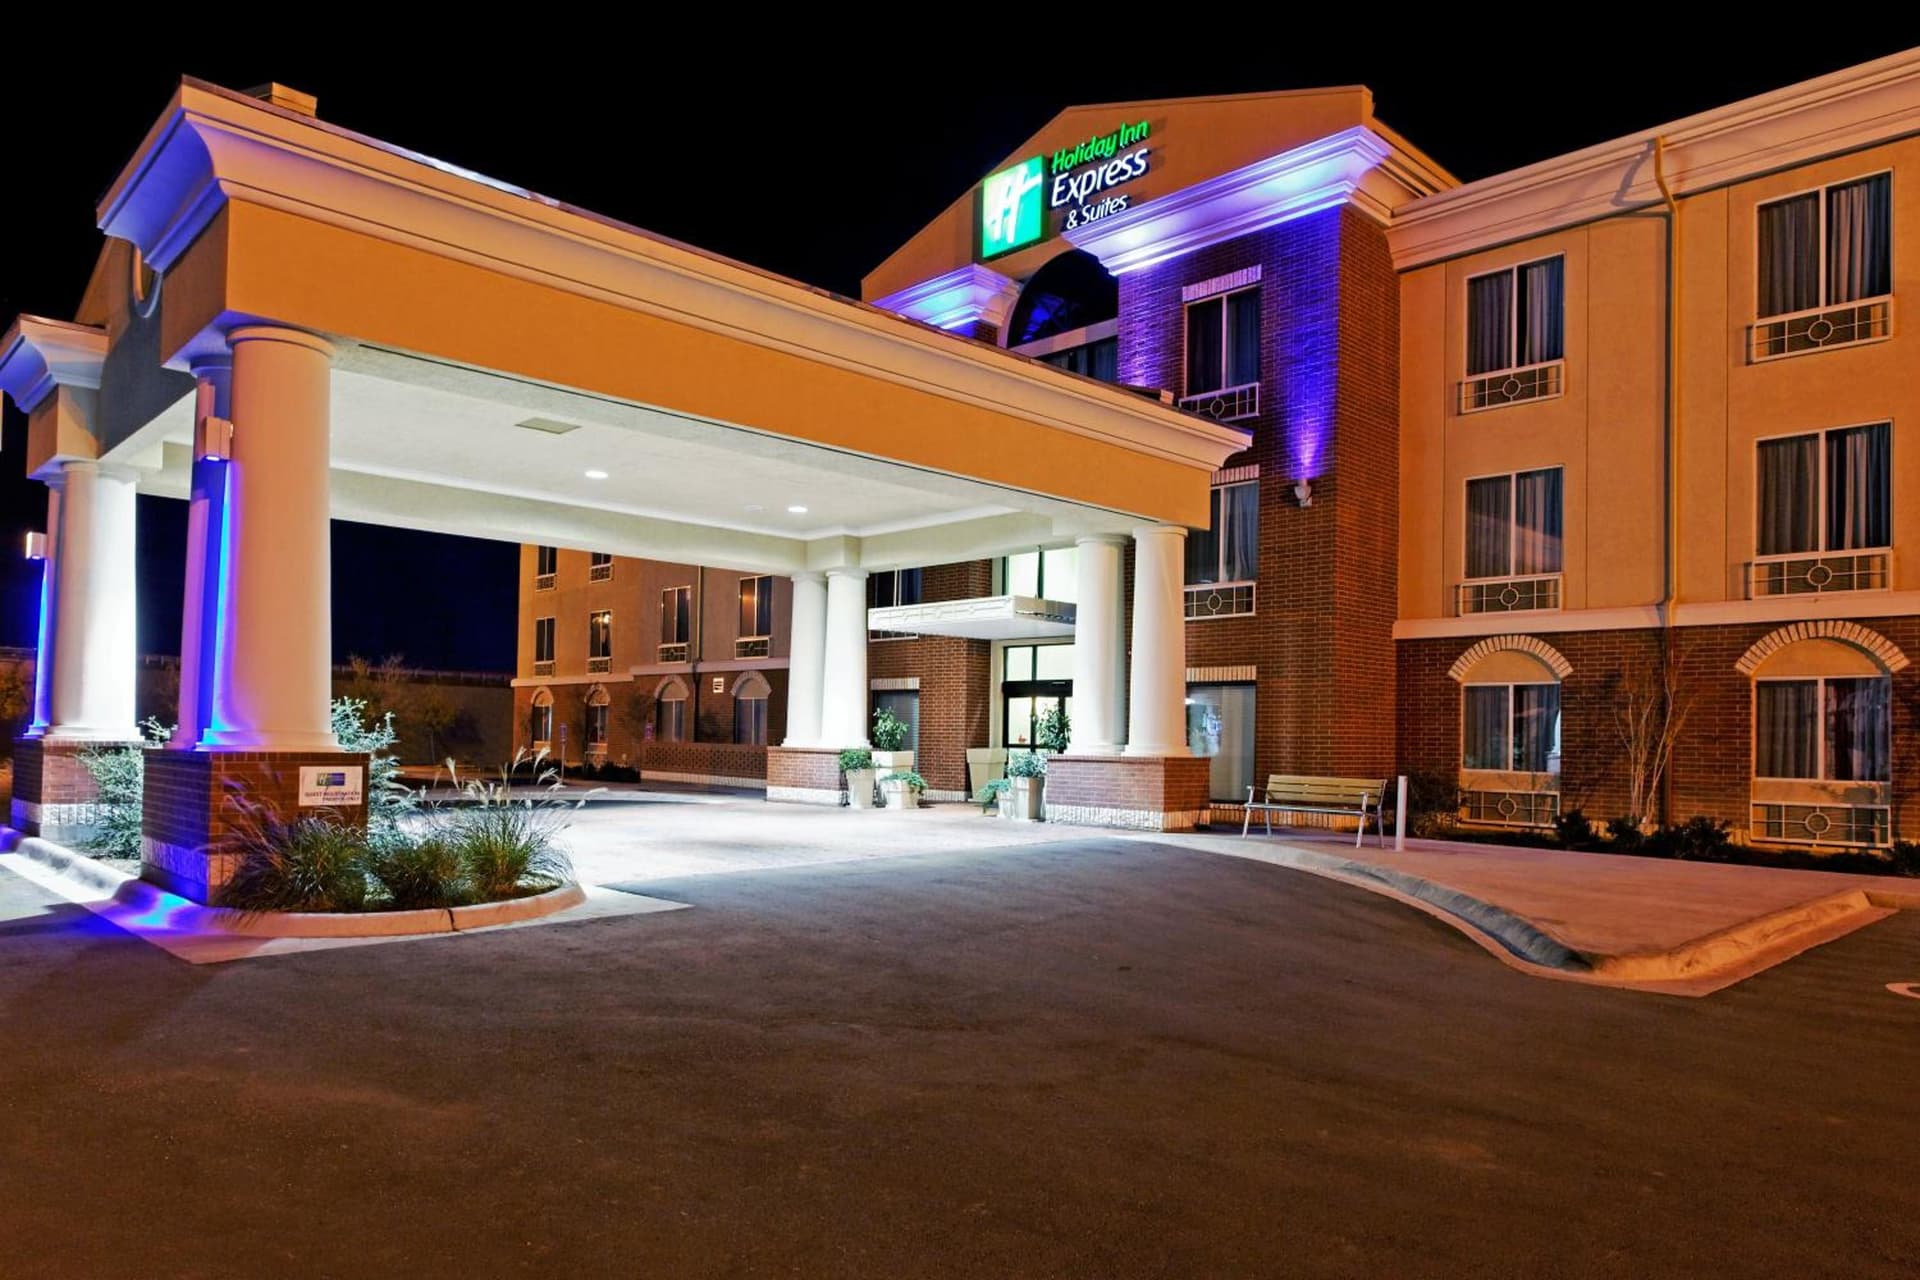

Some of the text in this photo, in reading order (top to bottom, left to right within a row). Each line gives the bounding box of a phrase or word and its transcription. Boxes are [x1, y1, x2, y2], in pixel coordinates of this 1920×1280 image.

[1051, 120, 1148, 173] Holiday Inn
[1051, 148, 1148, 207] Express
[1066, 195, 1128, 229] & Suites
